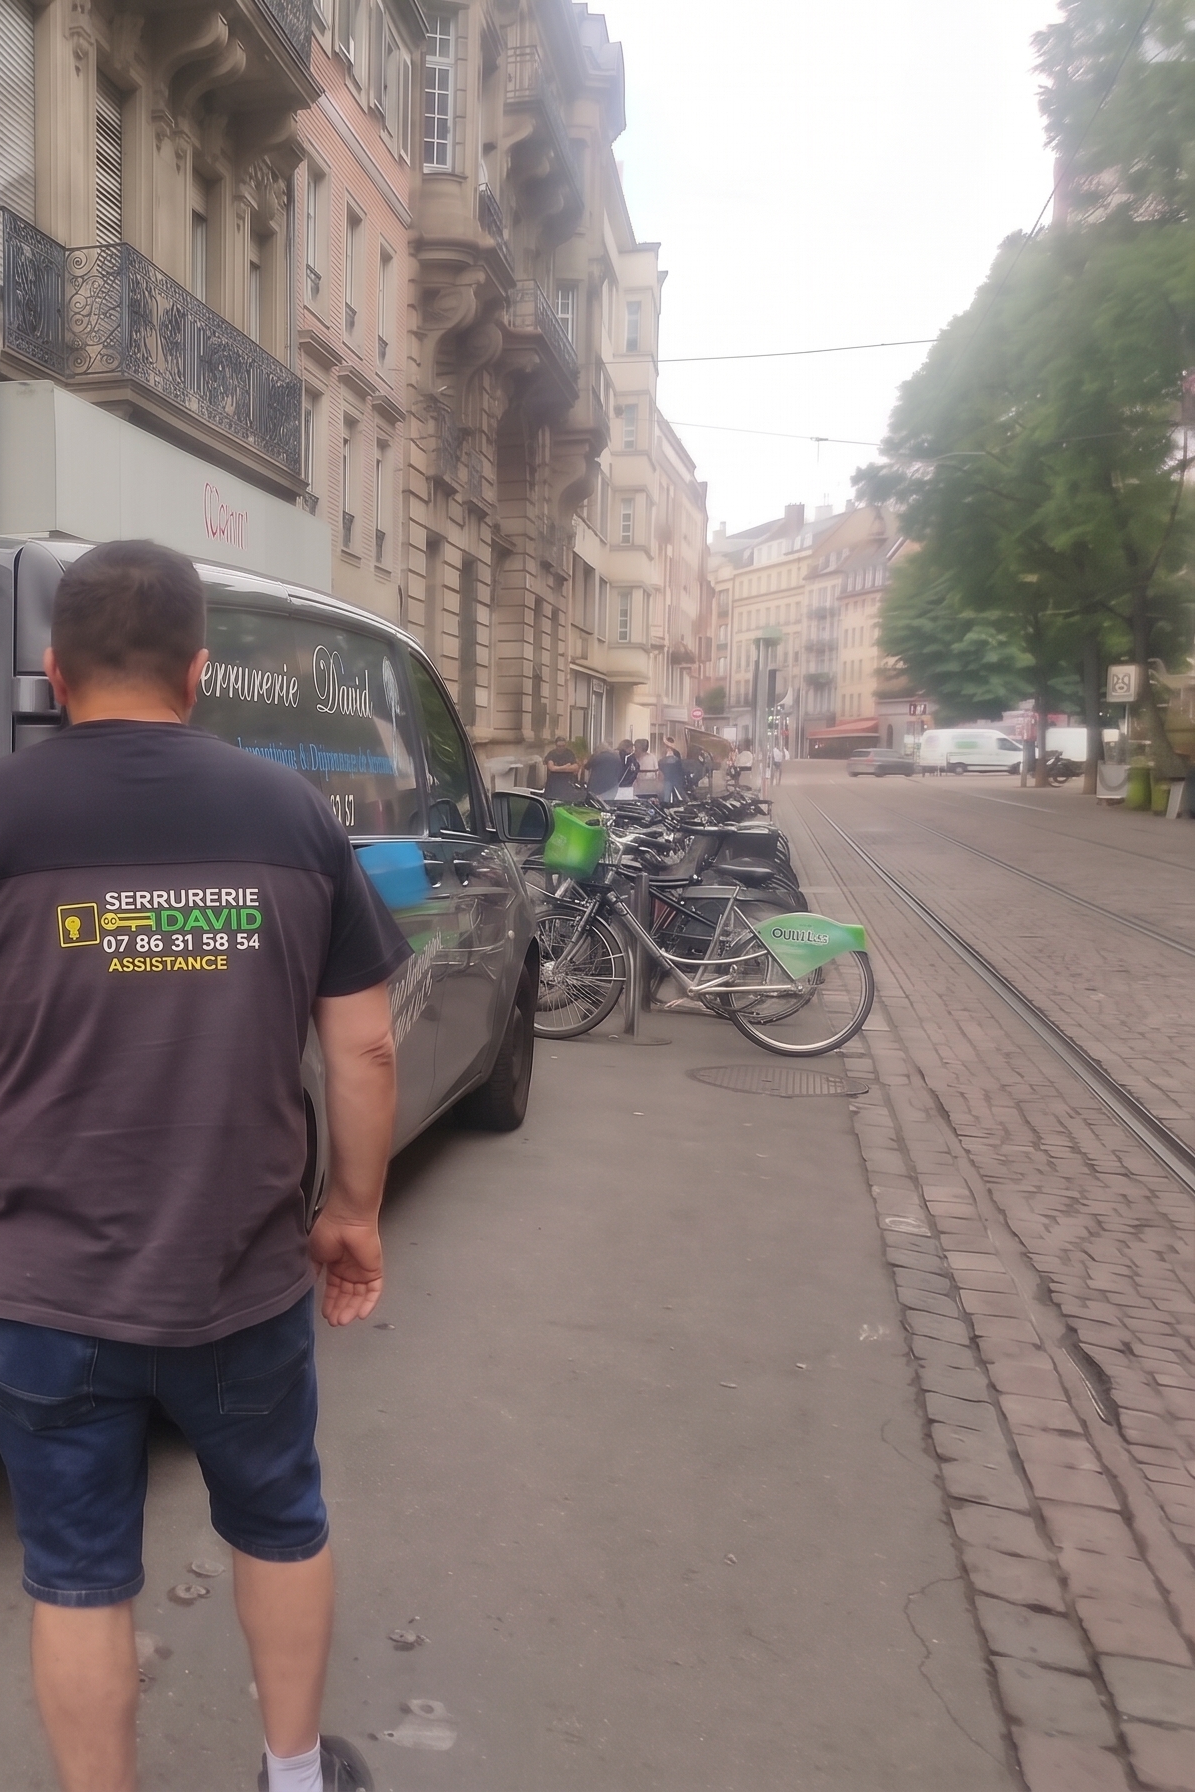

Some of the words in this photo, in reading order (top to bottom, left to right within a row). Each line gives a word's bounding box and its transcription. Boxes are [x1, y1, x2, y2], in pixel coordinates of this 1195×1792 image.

[199, 660, 299, 708] errurerie
[312, 645, 373, 718] David
[105, 888, 259, 910] SERRURERIE
[161, 908, 262, 931] DAVID
[103, 935, 129, 953] 07
[135, 934, 164, 952] 86
[171, 934, 193, 951] 31
[202, 933, 229, 950] 58
[236, 933, 260, 950] 54
[108, 955, 228, 973] ASSISTANCE
